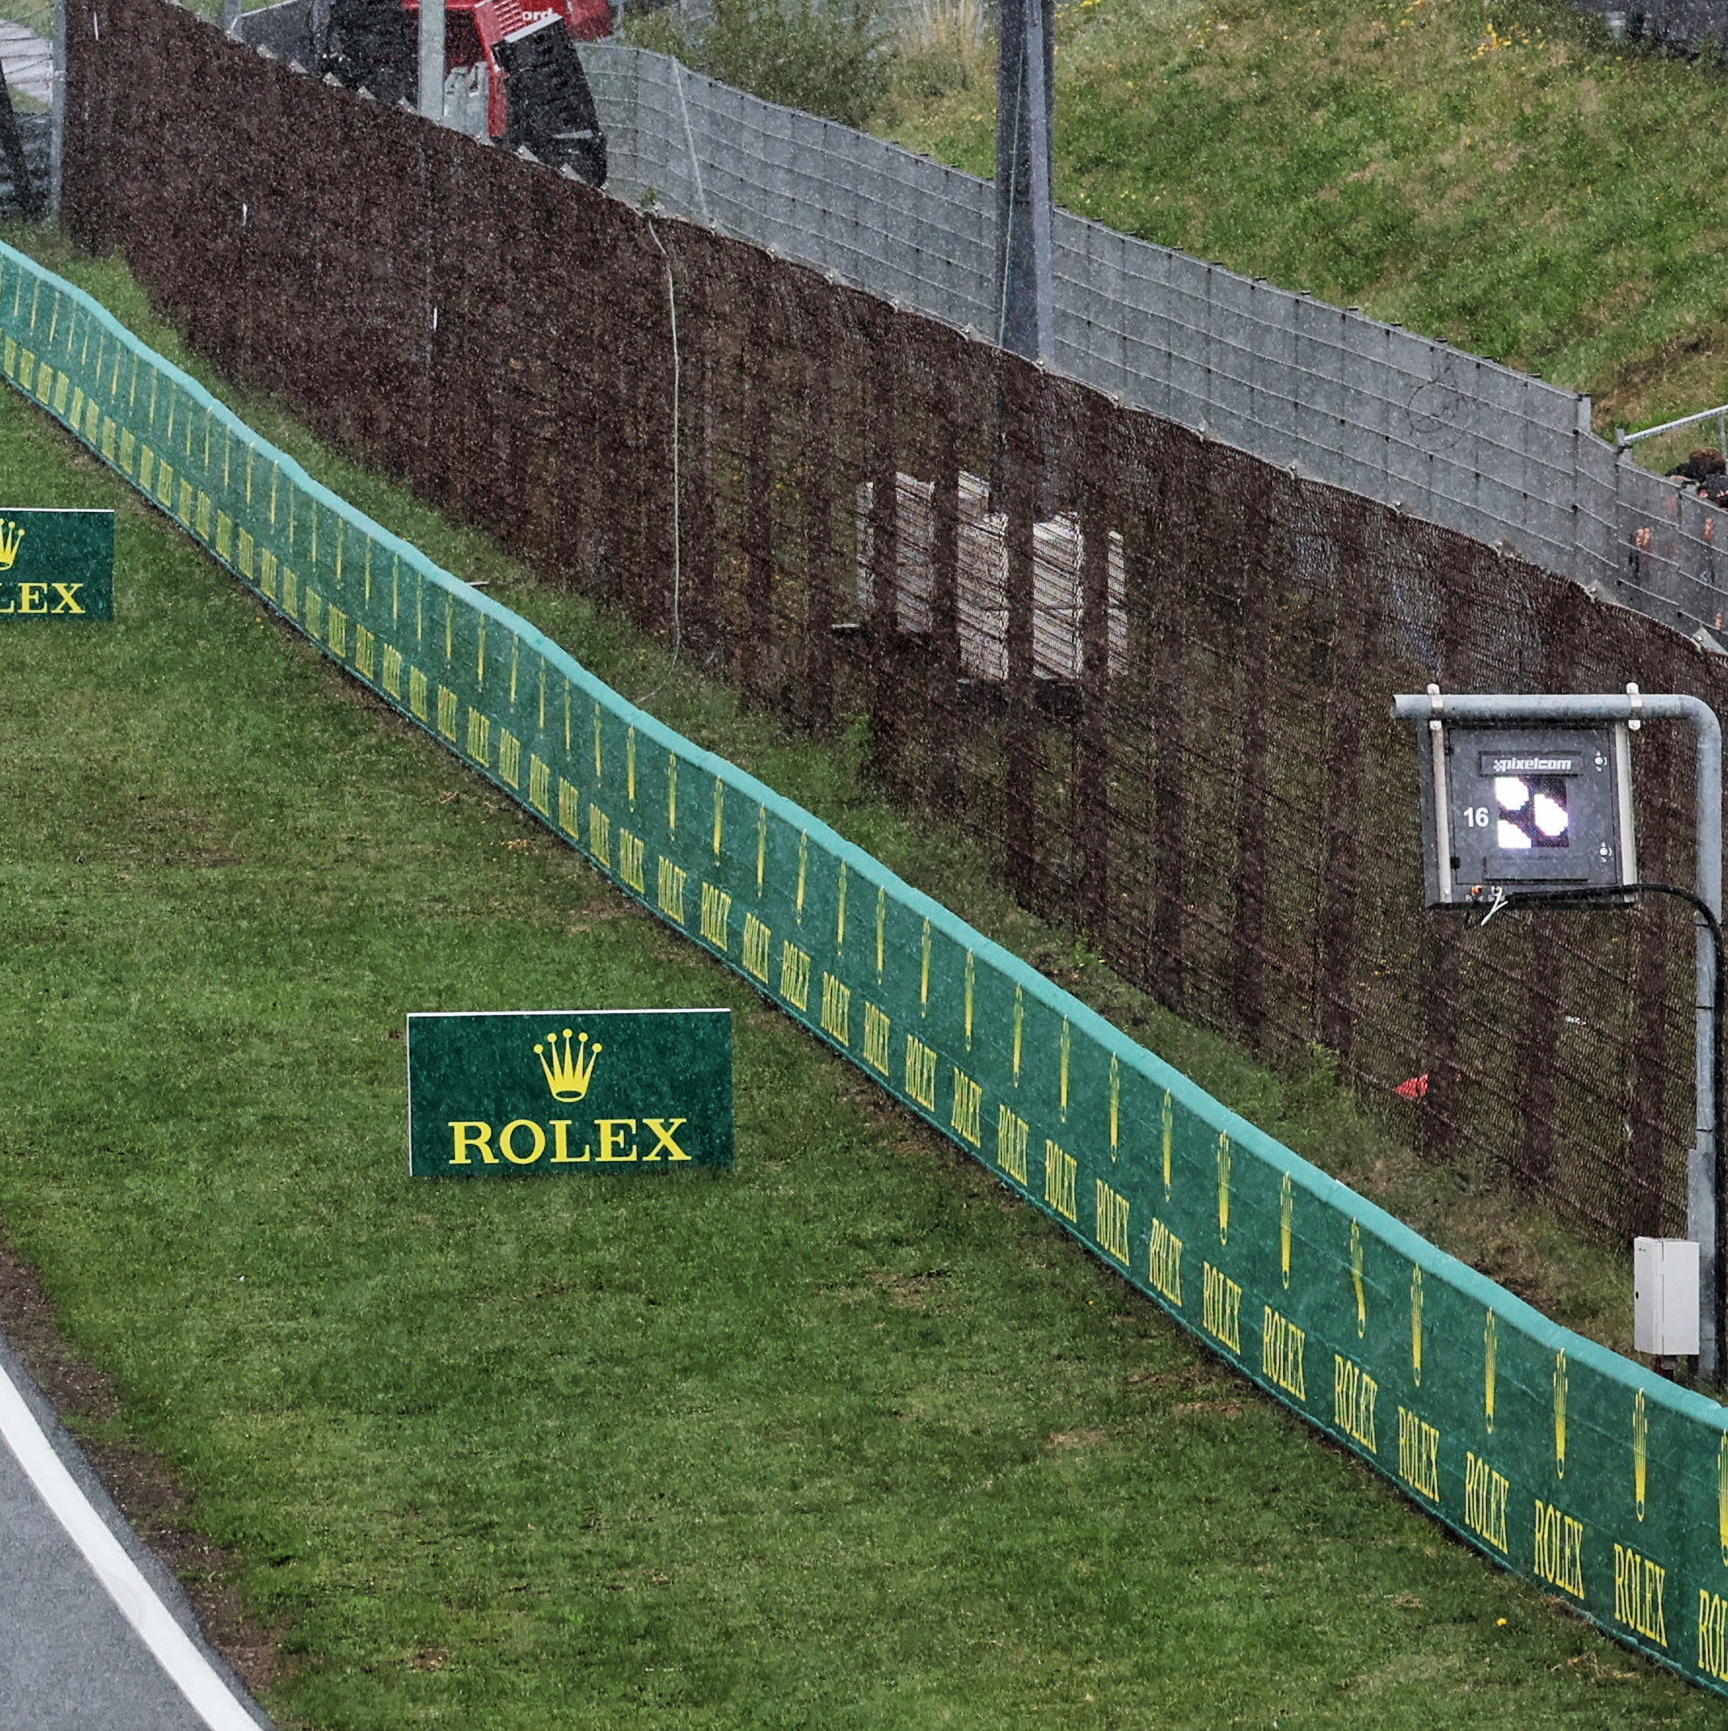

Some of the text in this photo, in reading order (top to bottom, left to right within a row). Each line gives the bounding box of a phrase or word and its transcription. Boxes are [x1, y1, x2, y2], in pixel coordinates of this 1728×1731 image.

[1501, 757, 1572, 772] pixelcom
[1463, 806, 1489, 828] 16
[448, 1118, 692, 1165] ROLEX
[1045, 1140, 1077, 1221] ROLEX
[1097, 1181, 1130, 1264] ROLEX
[1150, 1219, 1183, 1305] ROLEX
[1204, 1263, 1242, 1353] ROLEX
[1263, 1307, 1306, 1400] ROLEX
[1335, 1355, 1377, 1452] ROLEX
[1398, 1407, 1440, 1502] ROLEX
[1465, 1452, 1509, 1553] ROLEX
[1535, 1500, 1586, 1599] ROLEX
[1614, 1544, 1668, 1646] ROLEX
